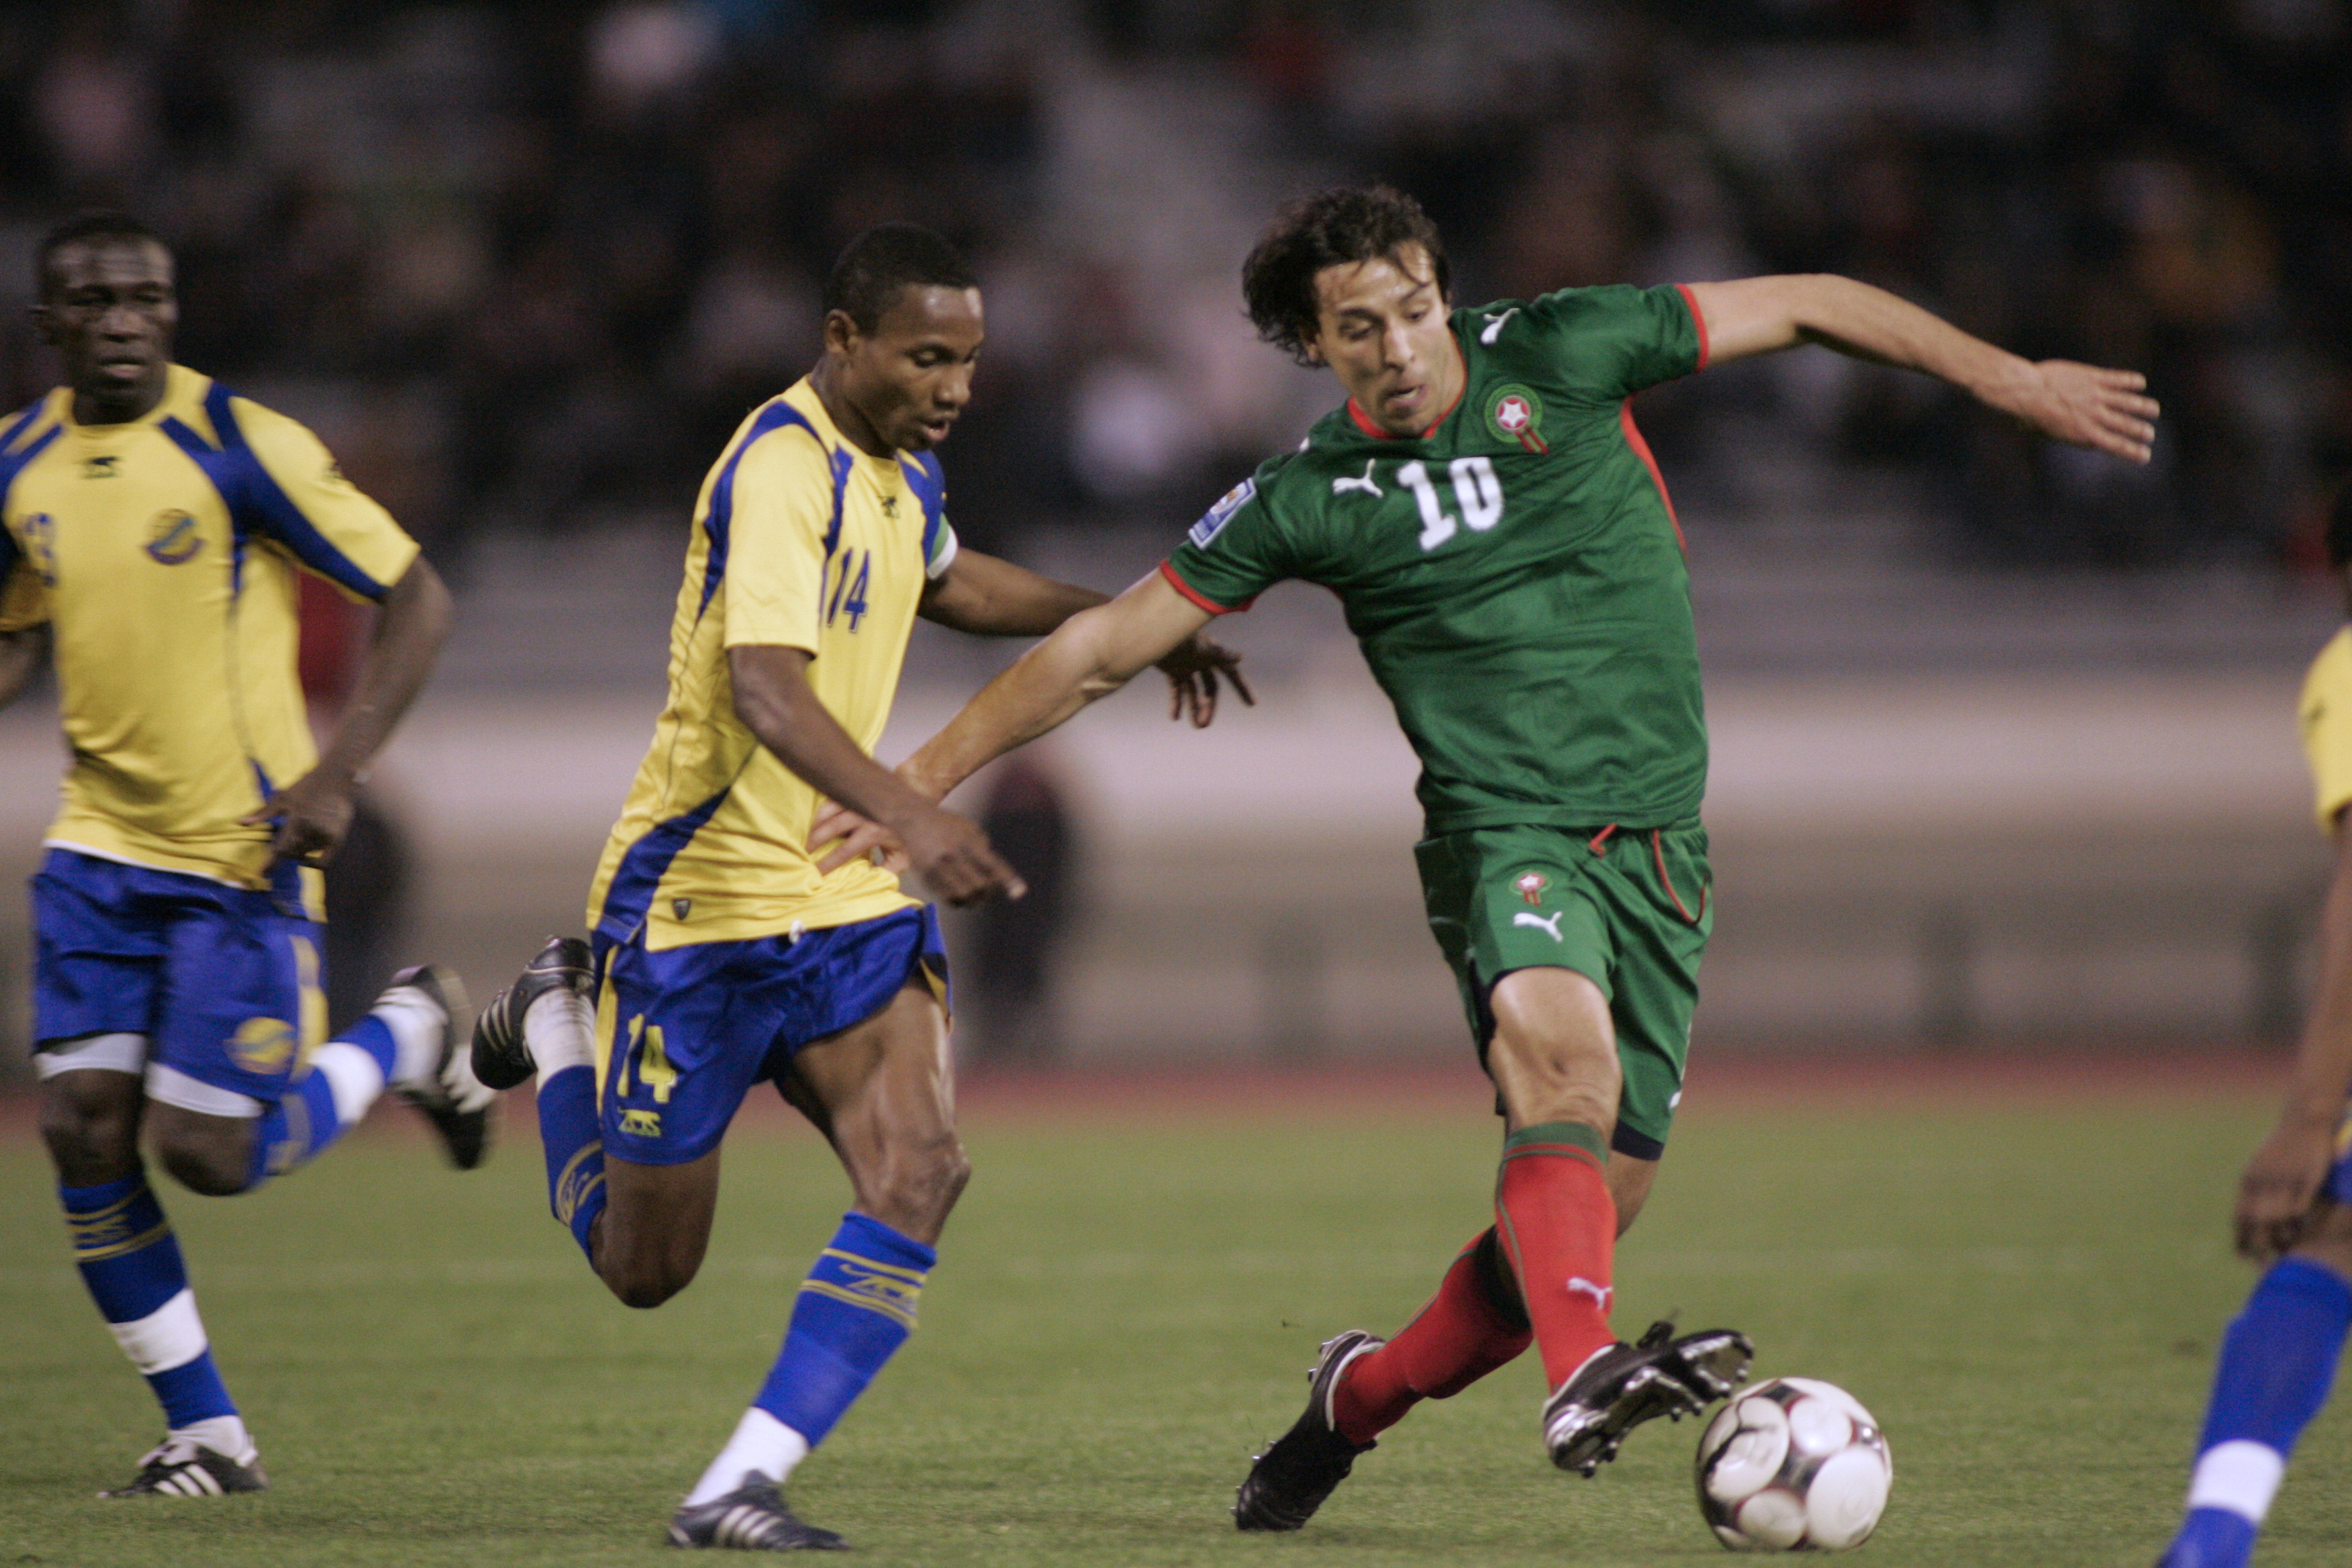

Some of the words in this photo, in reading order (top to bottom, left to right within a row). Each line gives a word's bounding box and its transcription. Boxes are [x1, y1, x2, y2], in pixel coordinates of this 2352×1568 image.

[1396, 456, 1504, 552] 10
[826, 547, 871, 634] 14
[617, 1013, 677, 1104] 14
